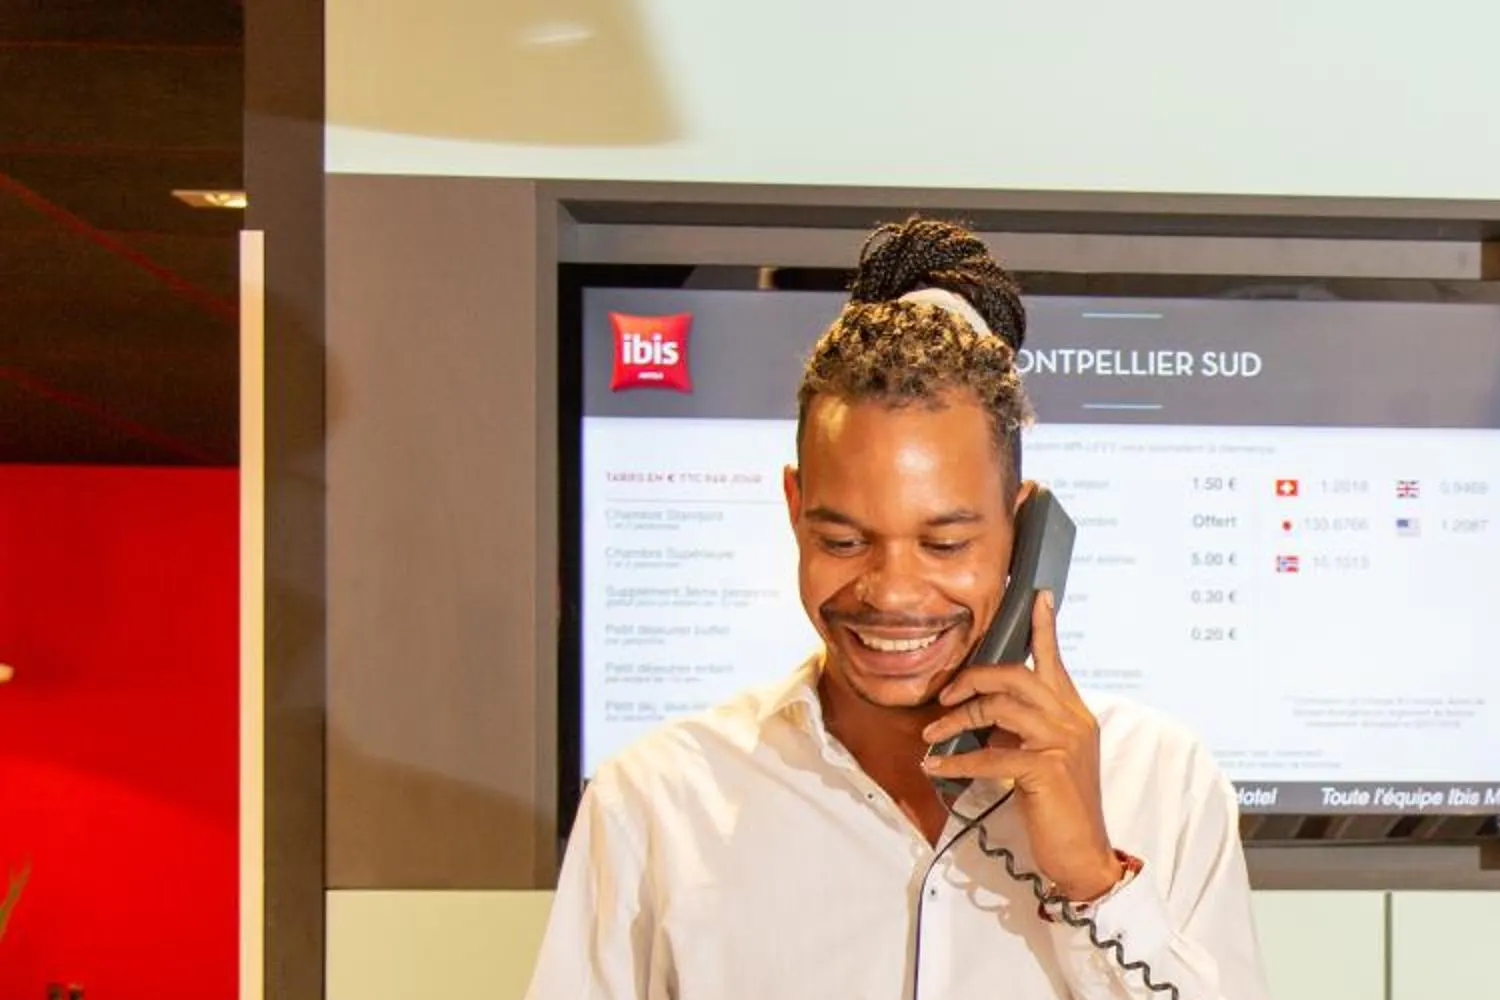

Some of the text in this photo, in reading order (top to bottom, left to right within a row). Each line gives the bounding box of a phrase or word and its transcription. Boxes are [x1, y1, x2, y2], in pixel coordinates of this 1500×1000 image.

[623, 332, 680, 365] ibis
[1015, 349, 1262, 377] ONTPELLIER SUD
[1192, 477, 1238, 491] 1.50 €
[1192, 514, 1237, 528] Offert
[1191, 552, 1238, 566] 5.00 €
[1228, 590, 1238, 604] €
[1228, 627, 1238, 640] €
[1321, 787, 1370, 805] Toute
[1374, 786, 1443, 810] l'équipe
[1448, 787, 1480, 805] Ibis
